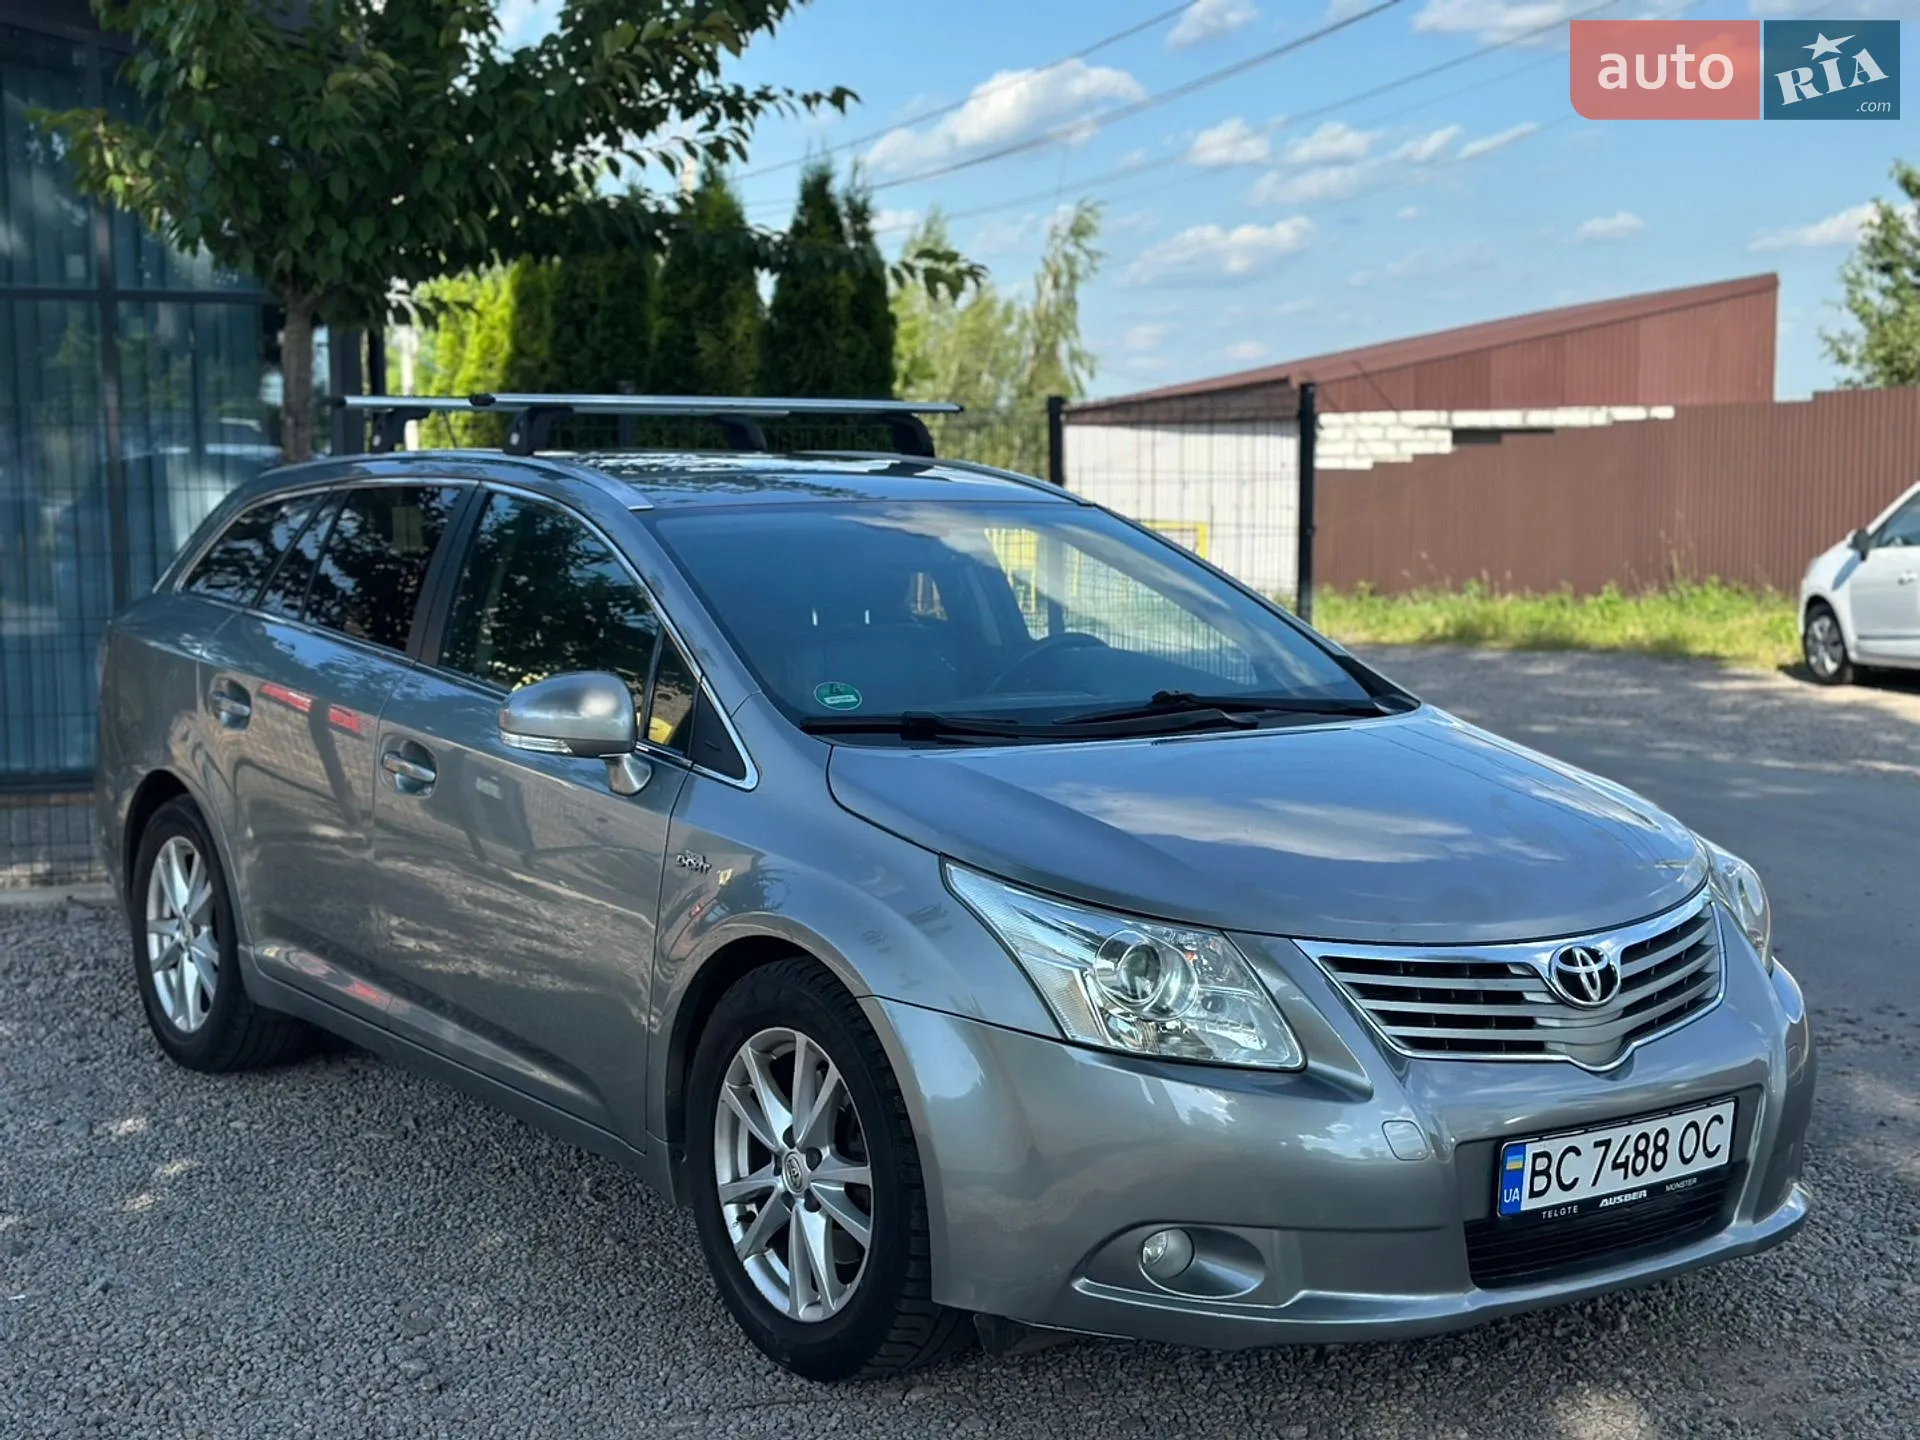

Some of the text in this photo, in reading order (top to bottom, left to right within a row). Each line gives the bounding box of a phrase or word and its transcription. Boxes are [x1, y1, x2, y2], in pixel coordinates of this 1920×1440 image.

[1528, 1114, 1725, 1200] BC 7488 OC
[1503, 1187, 1521, 1204] UA
